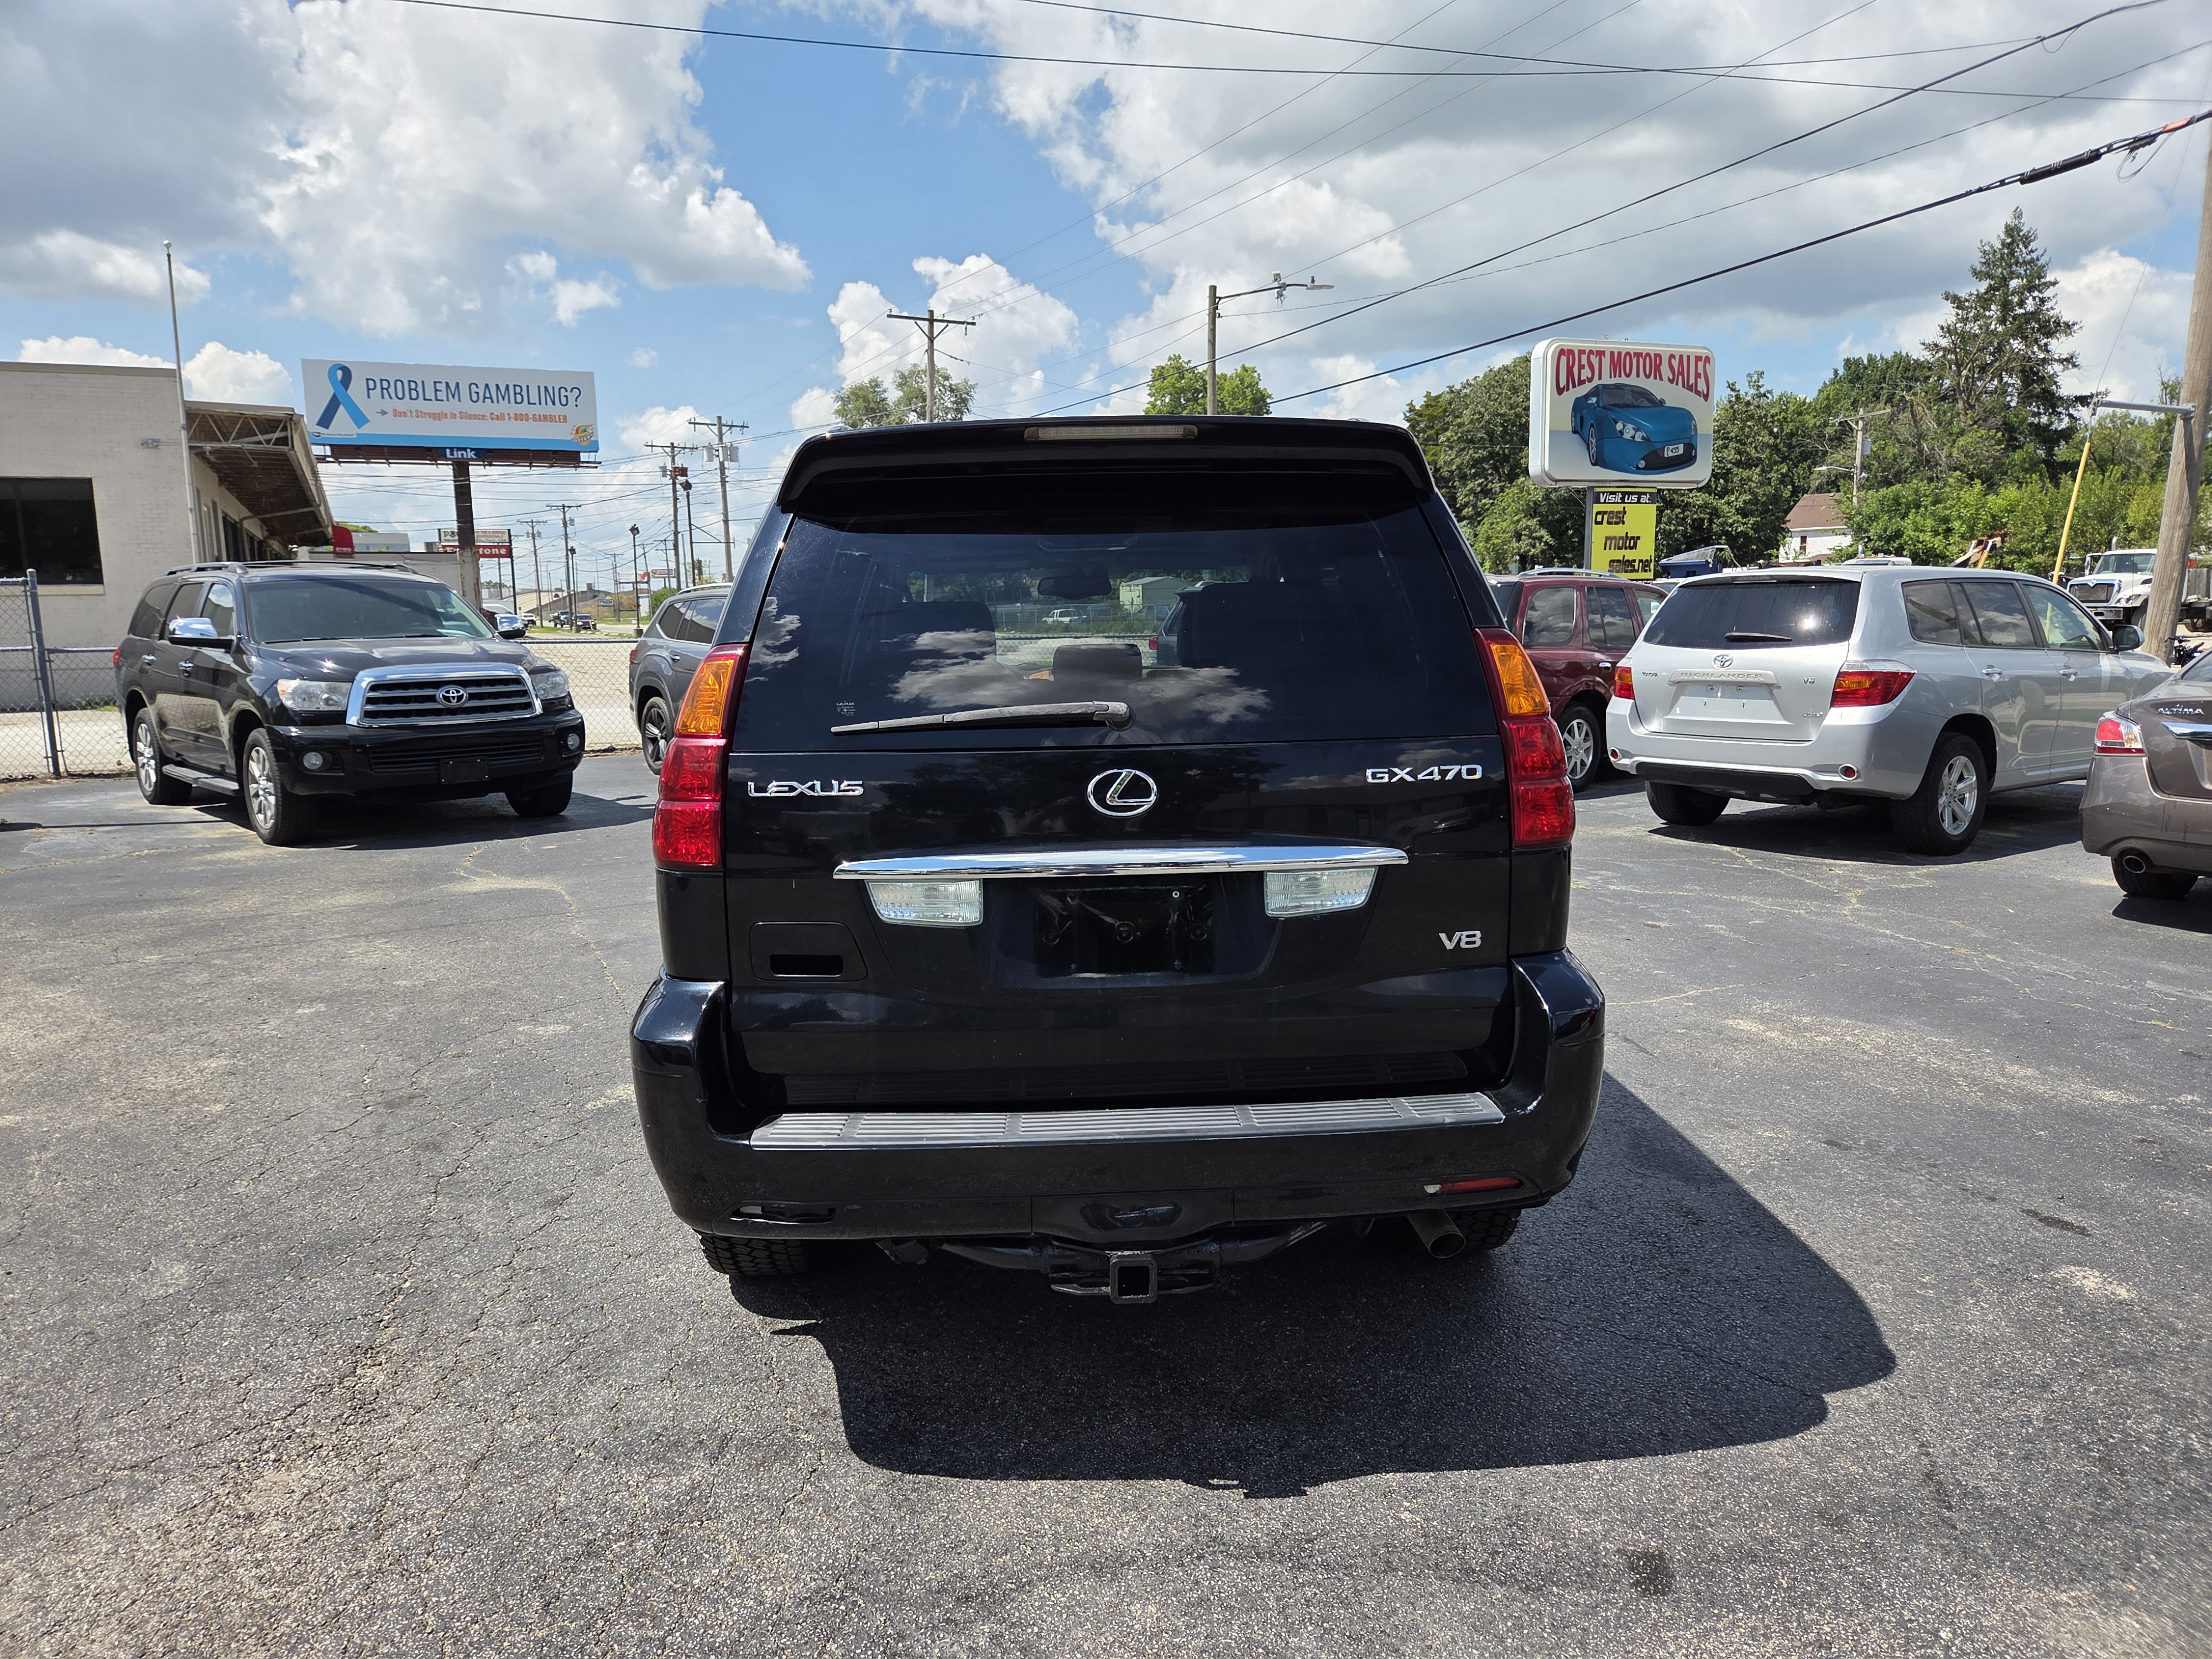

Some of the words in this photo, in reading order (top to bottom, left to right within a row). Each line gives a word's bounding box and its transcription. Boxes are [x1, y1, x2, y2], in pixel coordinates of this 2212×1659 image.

[1555, 348, 1606, 397] CREST
[1609, 351, 1663, 382] MOTOR
[1667, 353, 1711, 403] SALES
[365, 378, 462, 403] PROBLEM
[468, 382, 582, 408] GAMBLING?
[392, 408, 414, 418] Don't
[415, 409, 448, 421] Struggle
[450, 410, 457, 420] in
[489, 411, 505, 421] Call
[507, 412, 568, 424] 1-800-GAMBLER
[446, 448, 477, 458] Link
[1599, 493, 1623, 503] Visit
[1624, 494, 1637, 503] us
[1640, 493, 1652, 503] at:
[1594, 506, 1627, 525] crest
[1603, 531, 1641, 551] motor
[1608, 555, 1652, 573] sales.net
[1680, 672, 1765, 680] HIGHLANDER
[748, 780, 864, 796] LEXUS
[1438, 930, 1482, 950] V8
